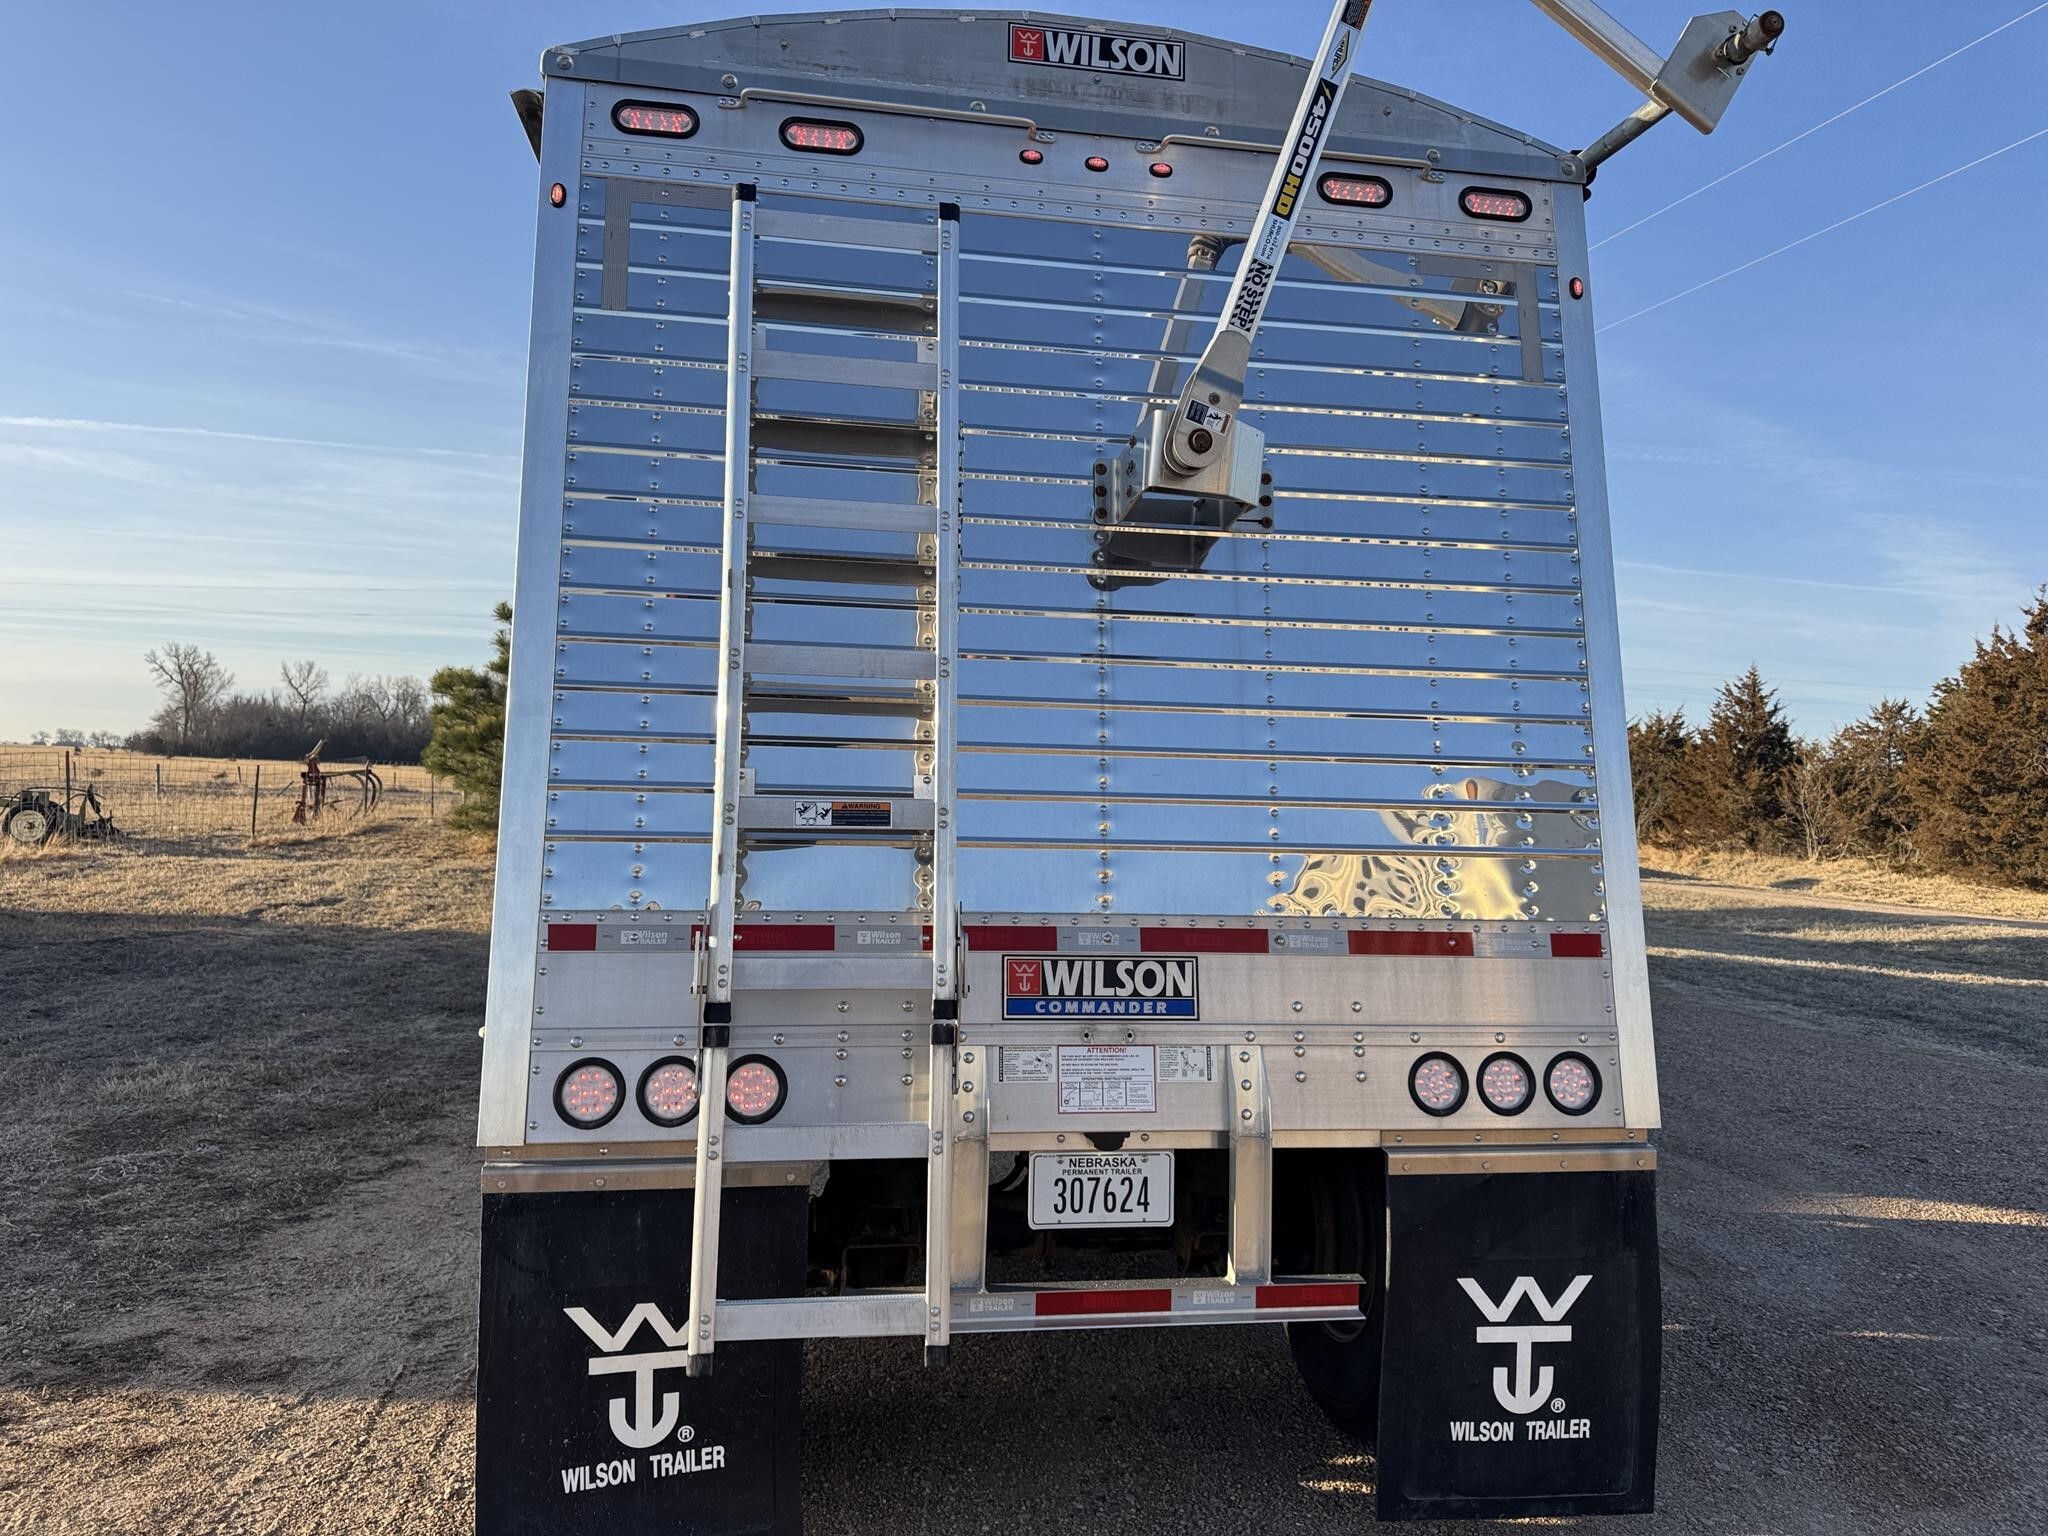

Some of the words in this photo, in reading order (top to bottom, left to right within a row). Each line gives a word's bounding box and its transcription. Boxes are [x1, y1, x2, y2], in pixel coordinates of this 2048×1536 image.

[1045, 30, 1180, 76] WILSON
[1276, 95, 1326, 216] 4500HD
[1252, 261, 1268, 286] NO
[1237, 288, 1258, 328] STEP
[871, 930, 901, 939] Wilson
[1043, 960, 1193, 997] WILSON
[1035, 1000, 1167, 1014] COMMANDER
[1062, 1168, 1109, 1176] PERMANENT
[1069, 1157, 1137, 1168] NEBRASKA
[1053, 1176, 1150, 1214] 307624
[984, 1297, 1014, 1306] Wilson
[1450, 1421, 1515, 1442] WILSON
[1526, 1418, 1591, 1441] TRAILER
[561, 1458, 636, 1494] WILSON
[650, 1445, 725, 1479] TRAILER
